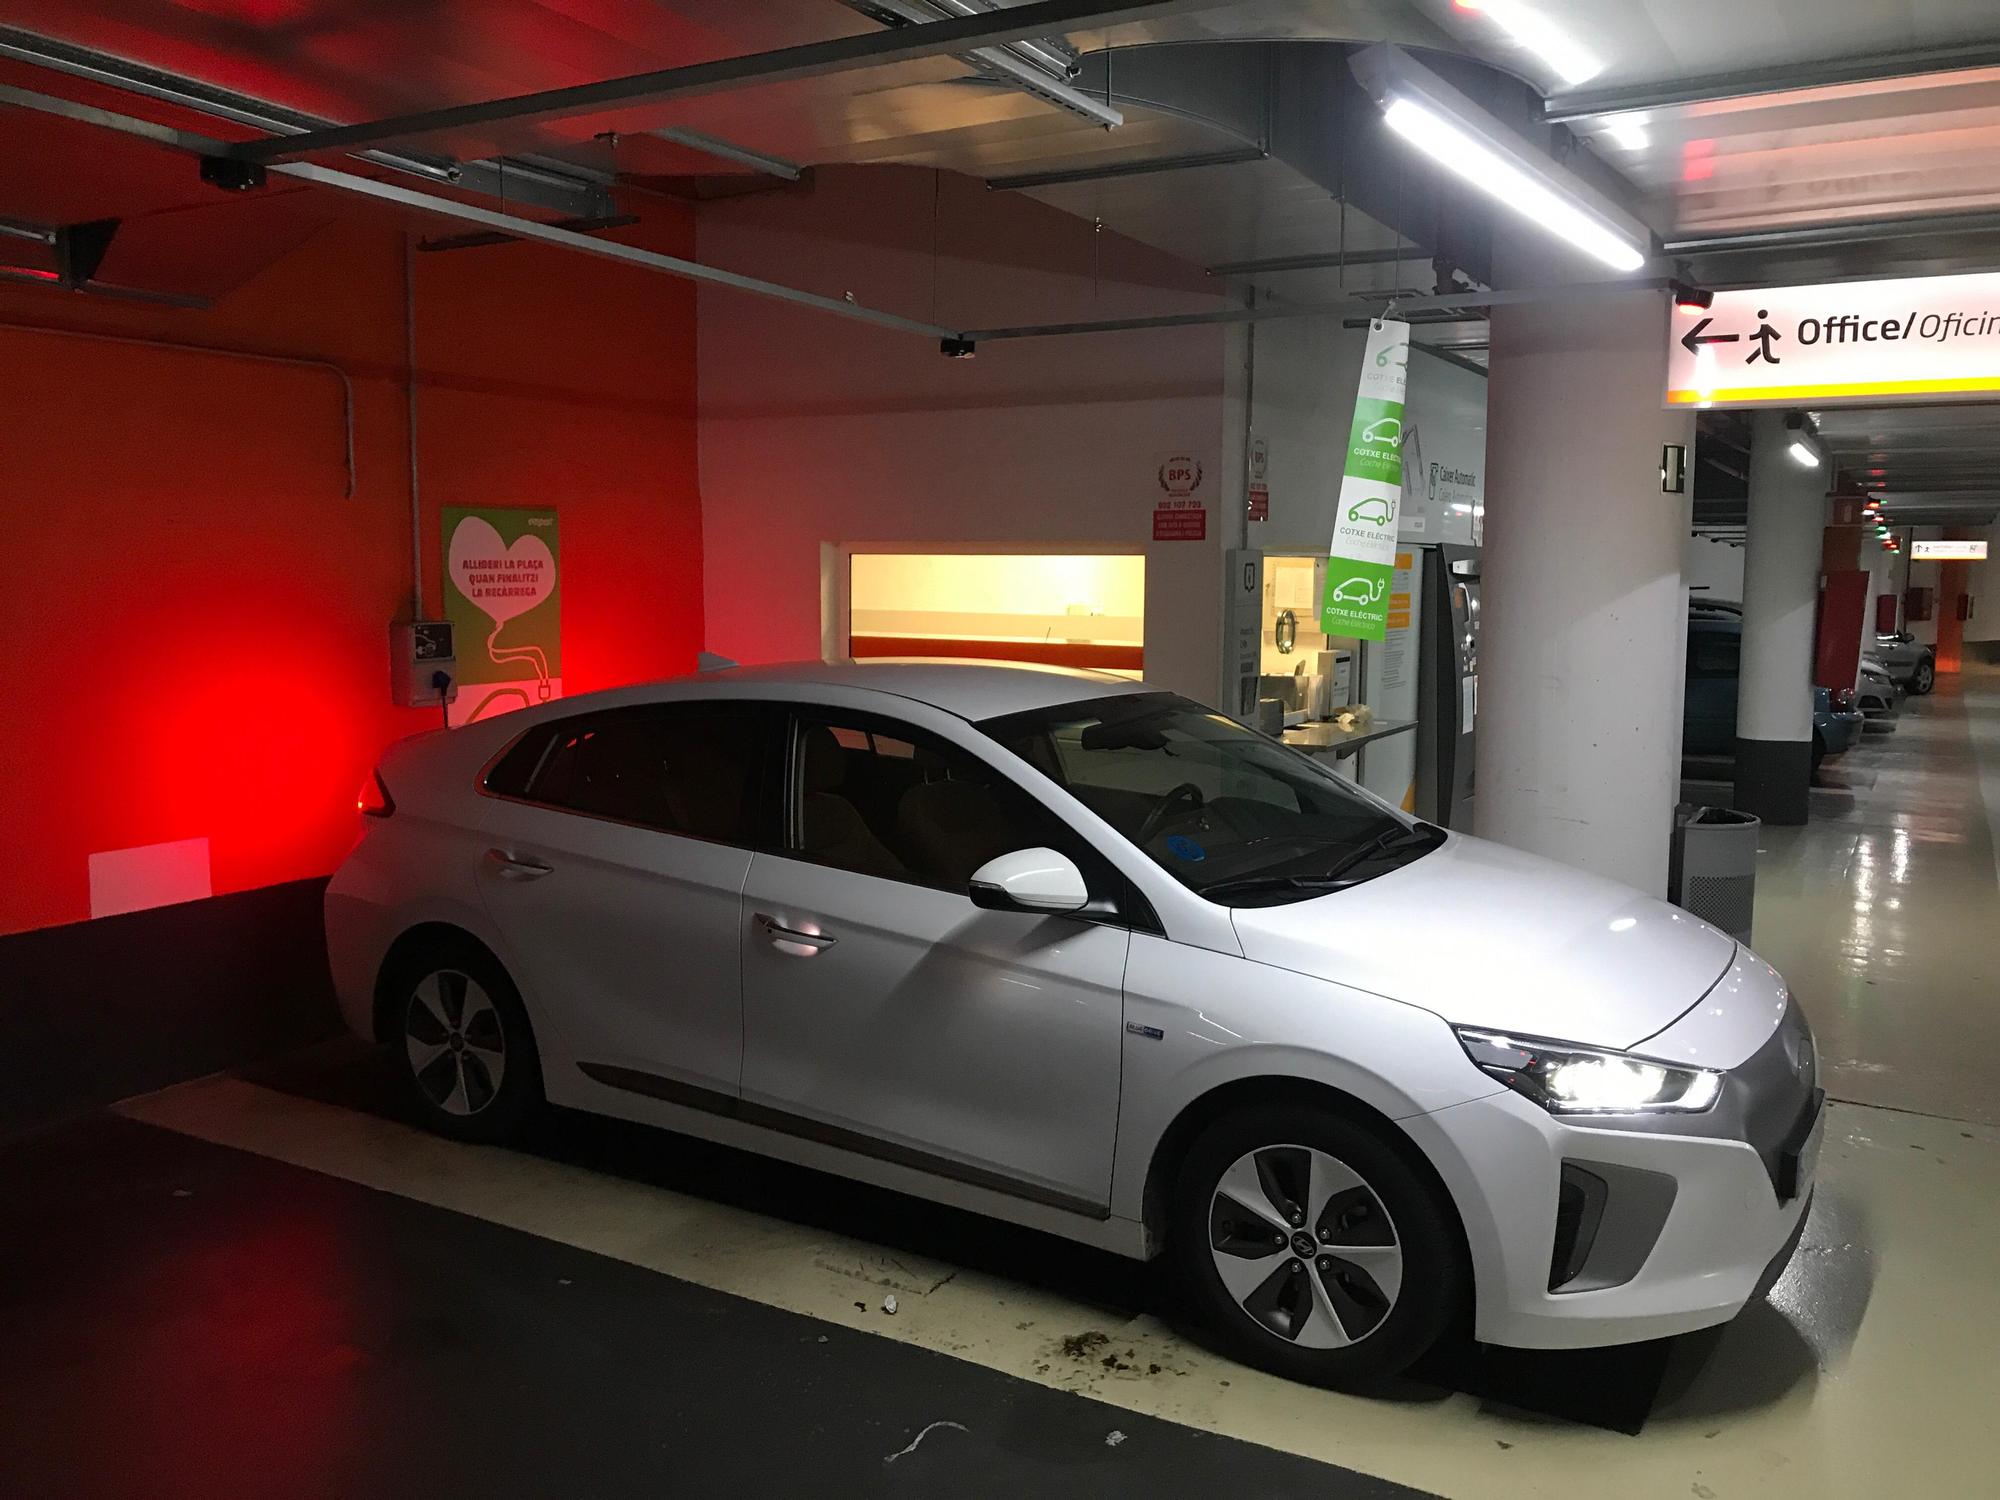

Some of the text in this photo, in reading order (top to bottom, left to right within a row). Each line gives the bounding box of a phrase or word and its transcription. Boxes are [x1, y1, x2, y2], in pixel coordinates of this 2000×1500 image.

[1353, 448, 1381, 458] COTXE
[1168, 469, 1191, 481] BPS
[1339, 527, 1366, 538] COTXE
[462, 559, 544, 571] ALLIBERI LA PLAÇA
[469, 574, 539, 585] QUAN FINALITZI
[472, 588, 483, 597] LA
[1326, 606, 1349, 616] COTXE
[1350, 610, 1383, 621] ELÉCTRIC
